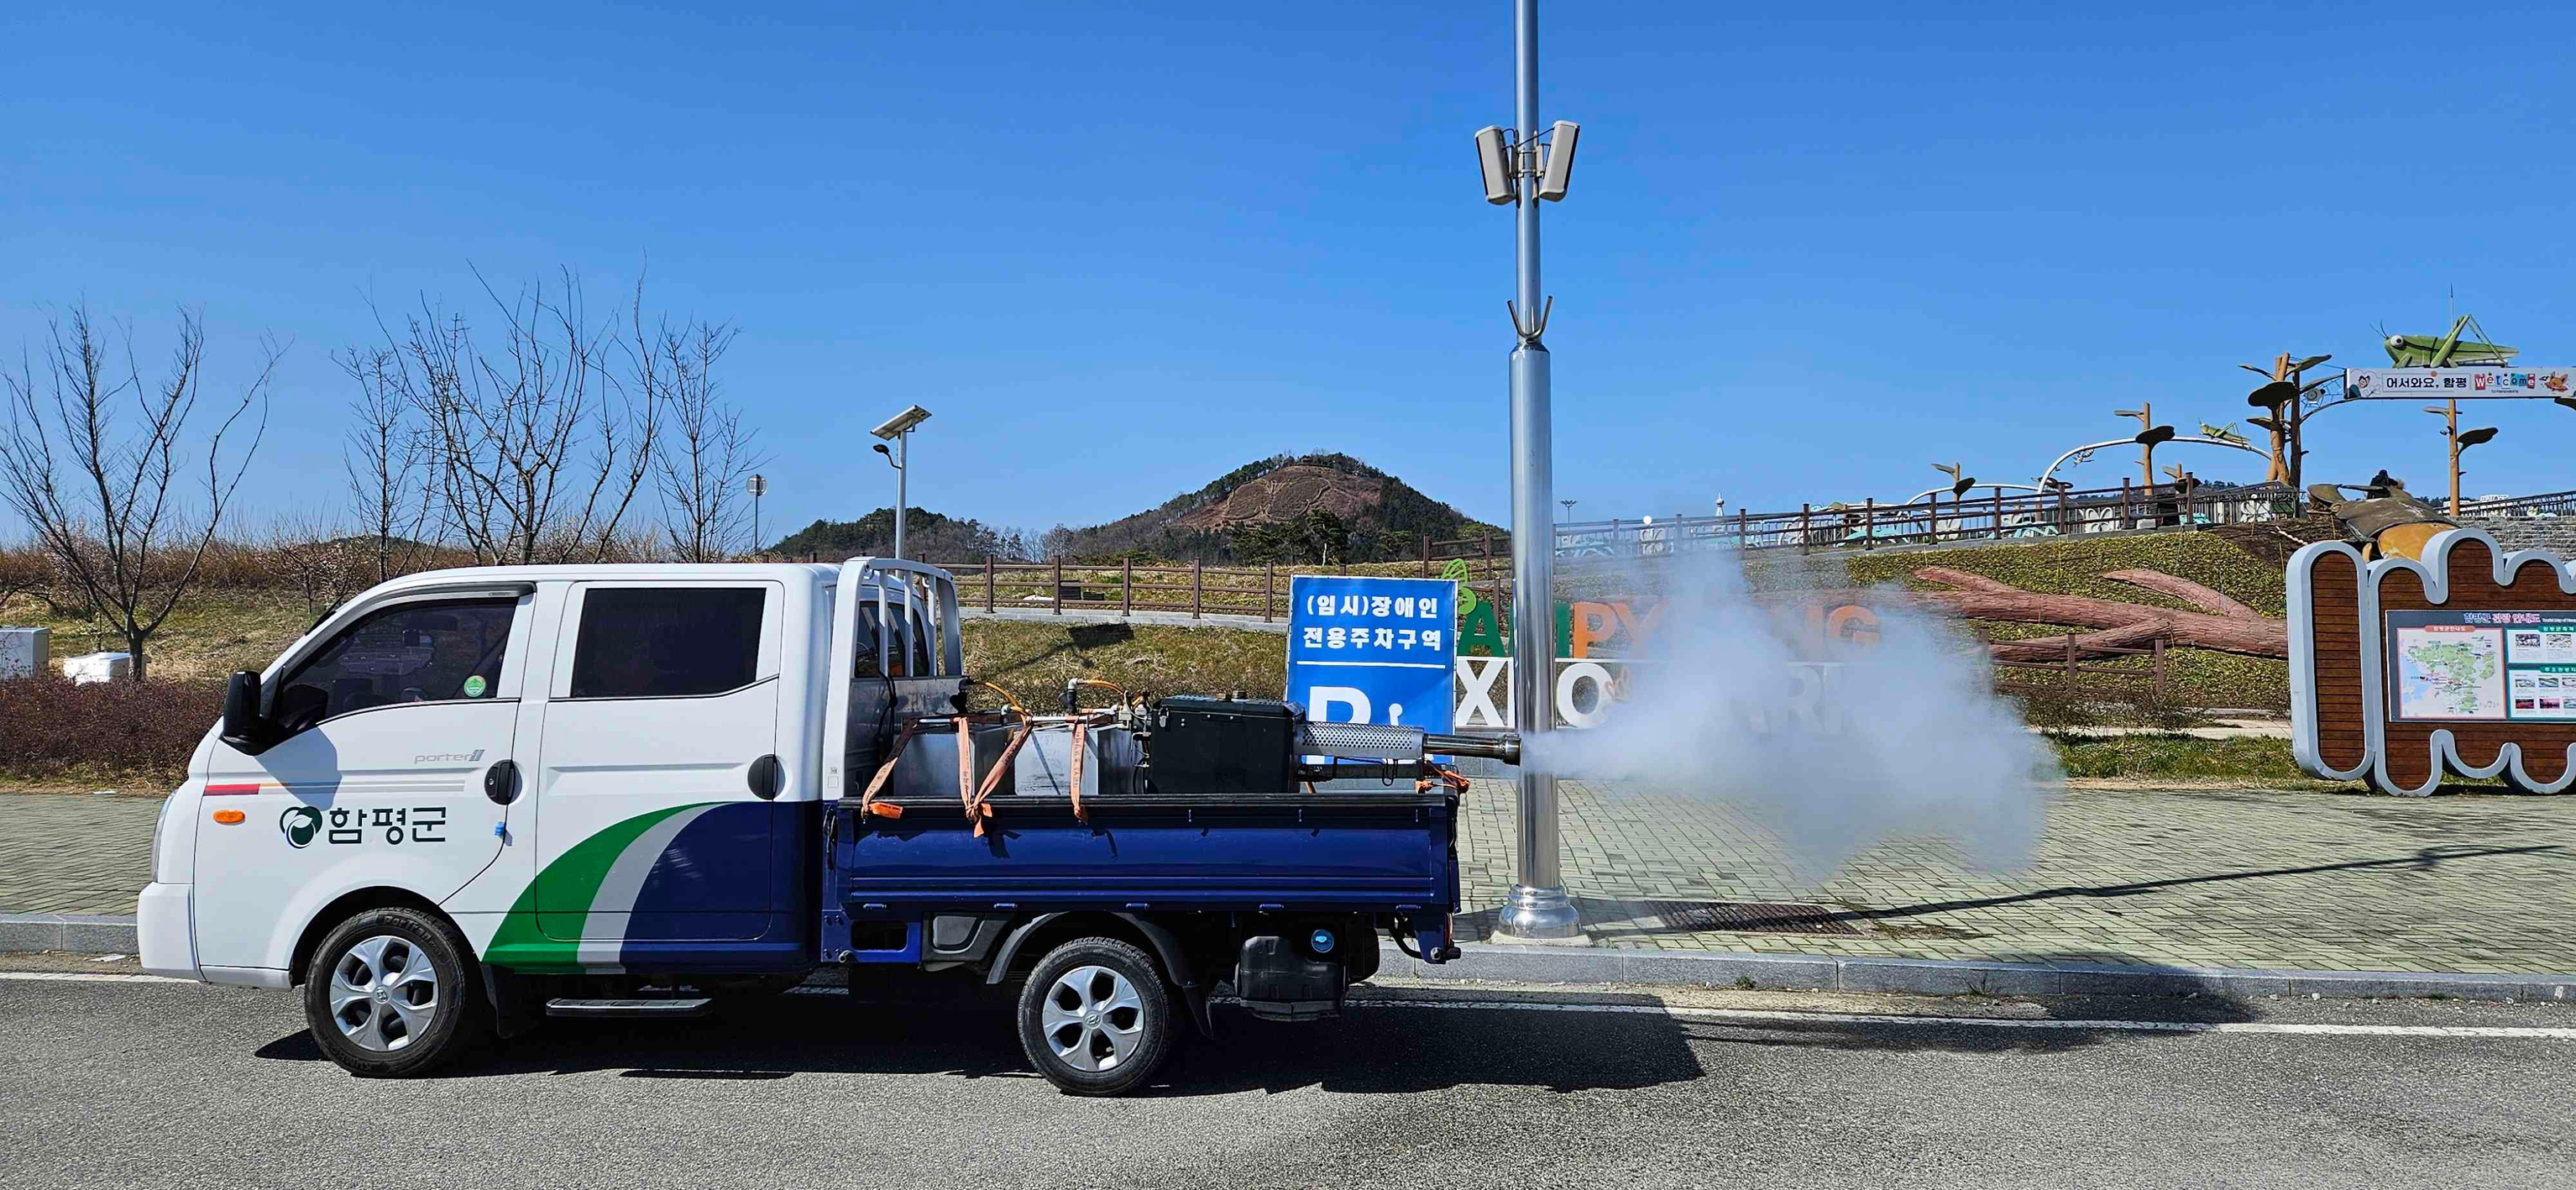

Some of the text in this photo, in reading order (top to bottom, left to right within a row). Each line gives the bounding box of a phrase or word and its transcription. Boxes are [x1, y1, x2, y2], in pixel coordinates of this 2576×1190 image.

[2386, 377, 2468, 389] 어서와요, 함평
[1306, 595, 1437, 619] (임시)장애인
[1303, 627, 1442, 652] 전용주차구역
[328, 807, 446, 845] 함평군
